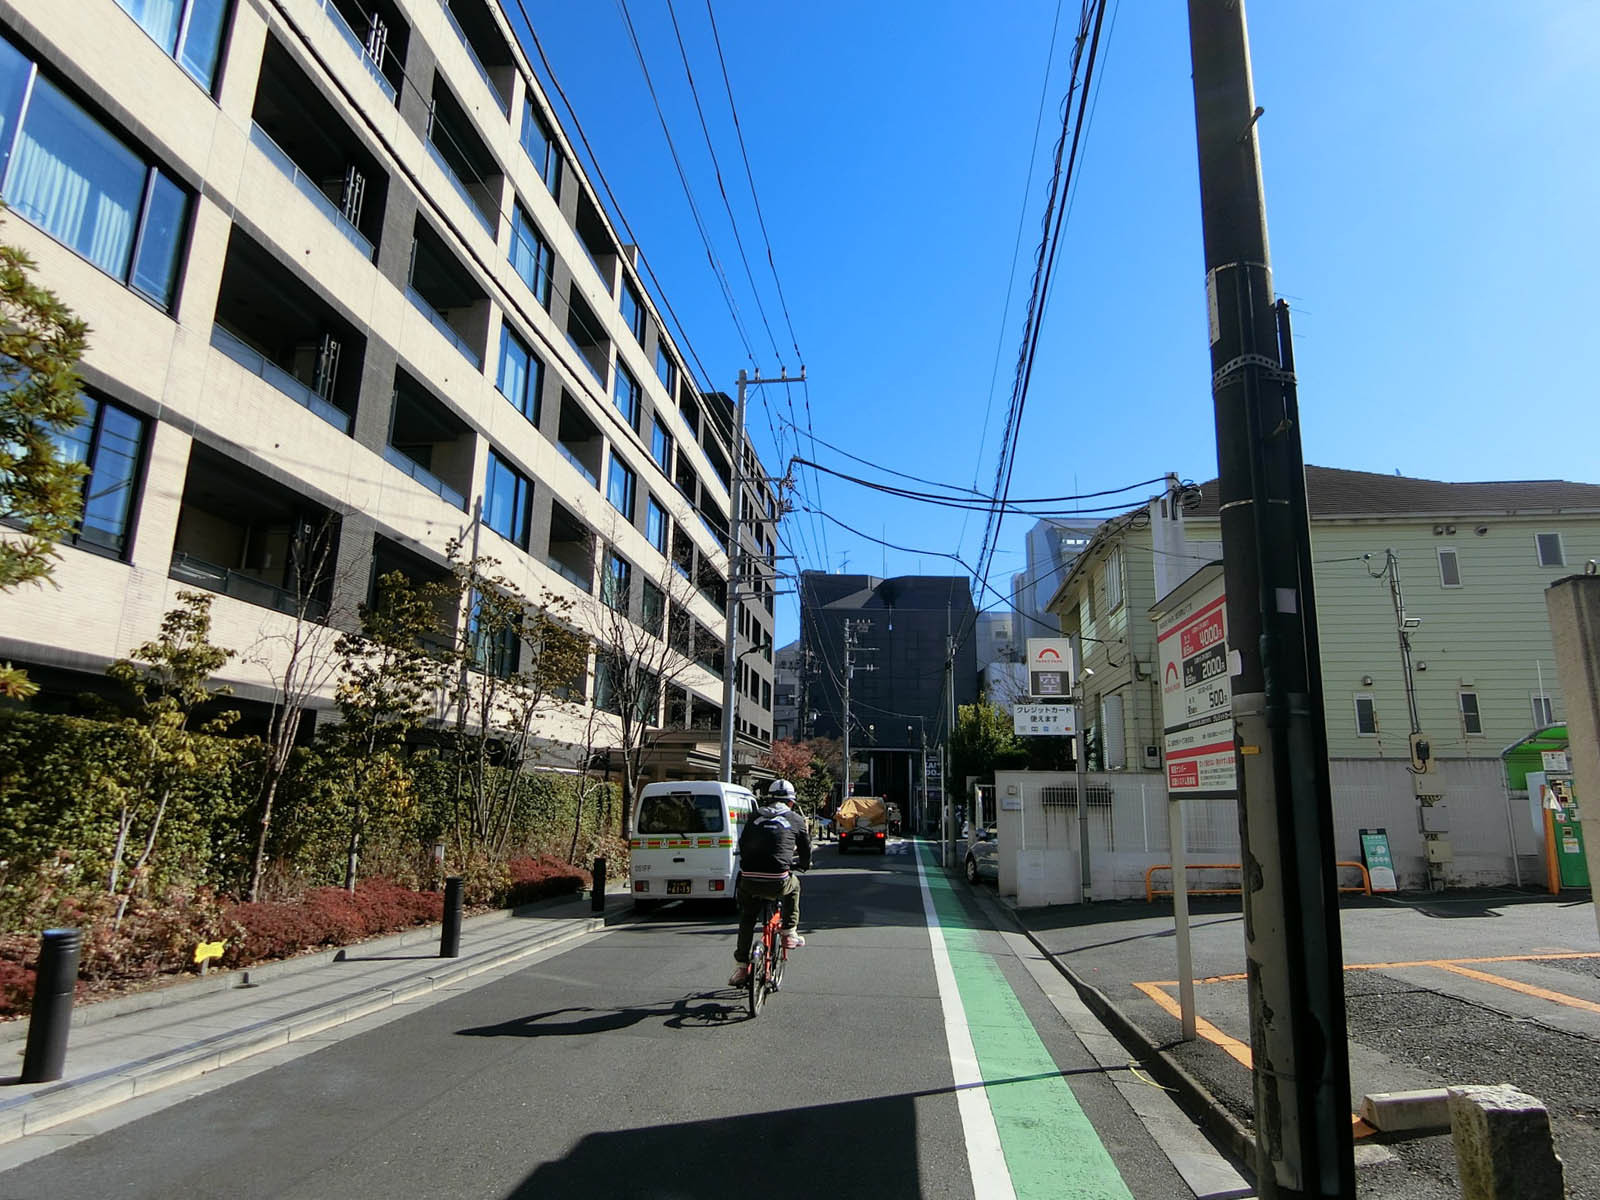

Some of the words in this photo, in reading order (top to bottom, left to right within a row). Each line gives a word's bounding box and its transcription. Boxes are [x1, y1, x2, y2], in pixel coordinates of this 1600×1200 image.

[1016, 706, 1073, 714] クレジットカード
[1030, 715, 1058, 723] 使えます
